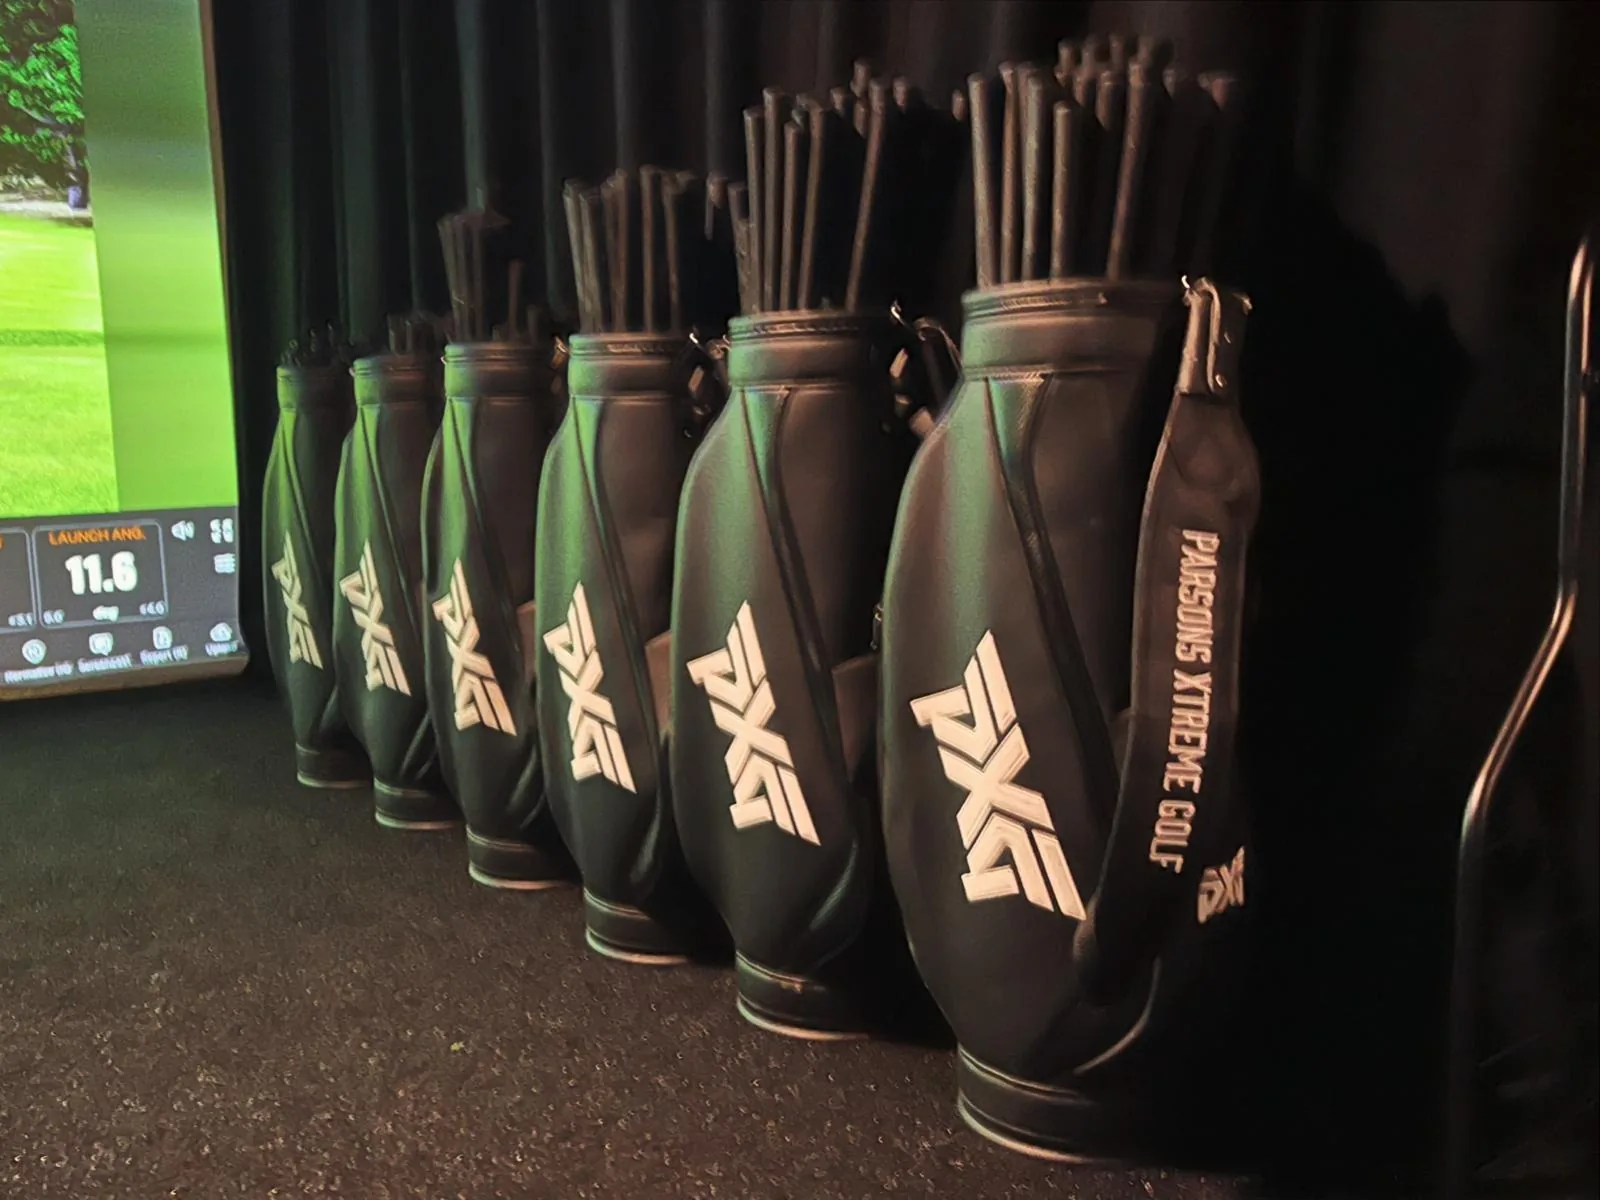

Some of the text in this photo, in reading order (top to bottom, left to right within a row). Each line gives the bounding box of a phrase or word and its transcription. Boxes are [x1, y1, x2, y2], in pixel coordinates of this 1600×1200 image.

[48, 528, 109, 545] LAUNCH
[65, 551, 138, 595] 11.6
[1150, 529, 1220, 874] PARSONS XTREME GOLF
